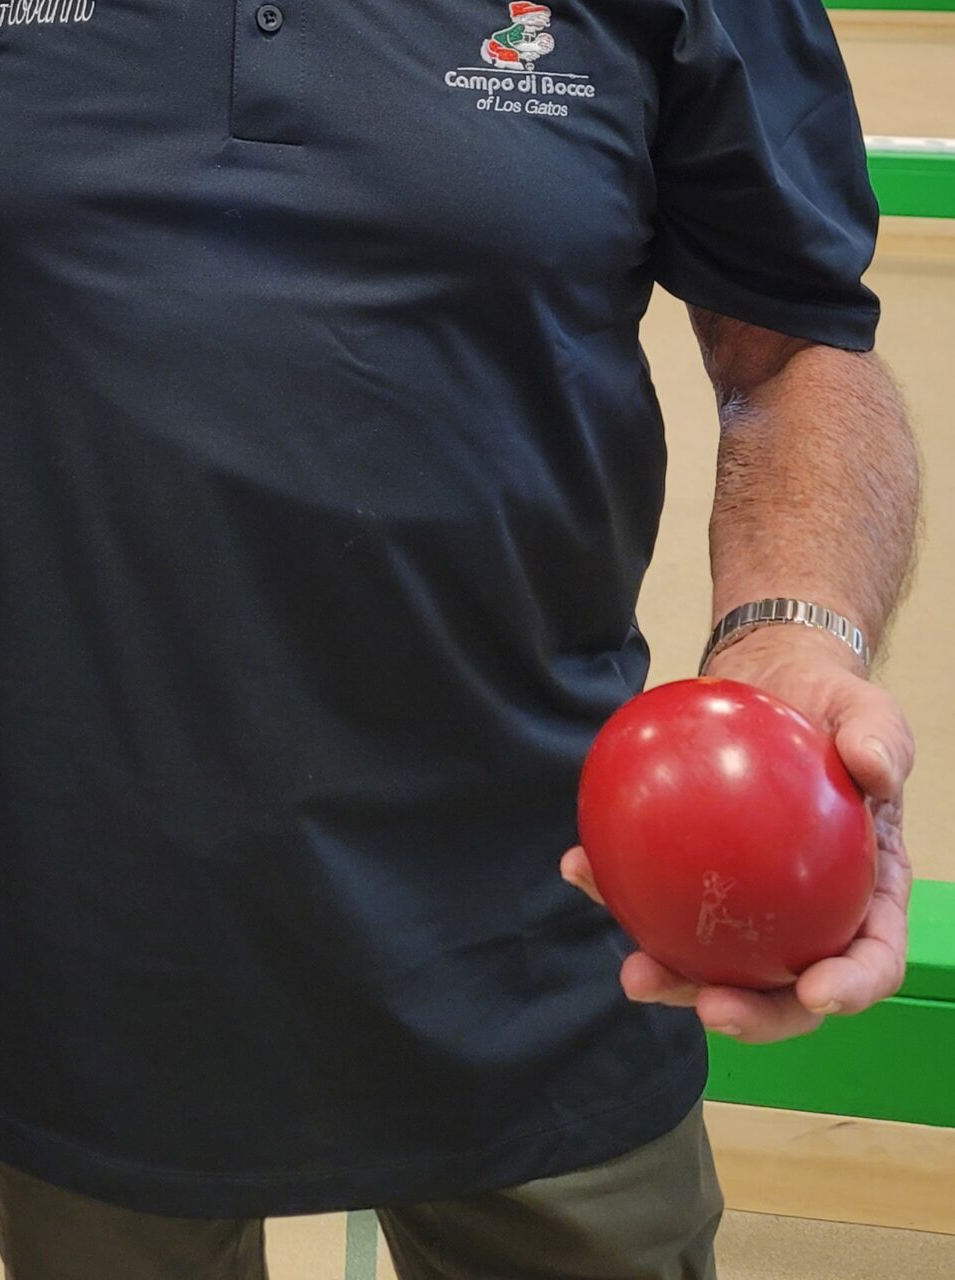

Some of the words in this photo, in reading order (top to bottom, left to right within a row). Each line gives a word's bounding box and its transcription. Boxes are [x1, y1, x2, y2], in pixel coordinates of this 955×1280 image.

[444, 71, 514, 94] Campo
[517, 74, 537, 94] di
[541, 76, 595, 97] Bocce
[476, 96, 494, 110] of
[495, 96, 521, 112] Los
[525, 99, 568, 116] Gatos
